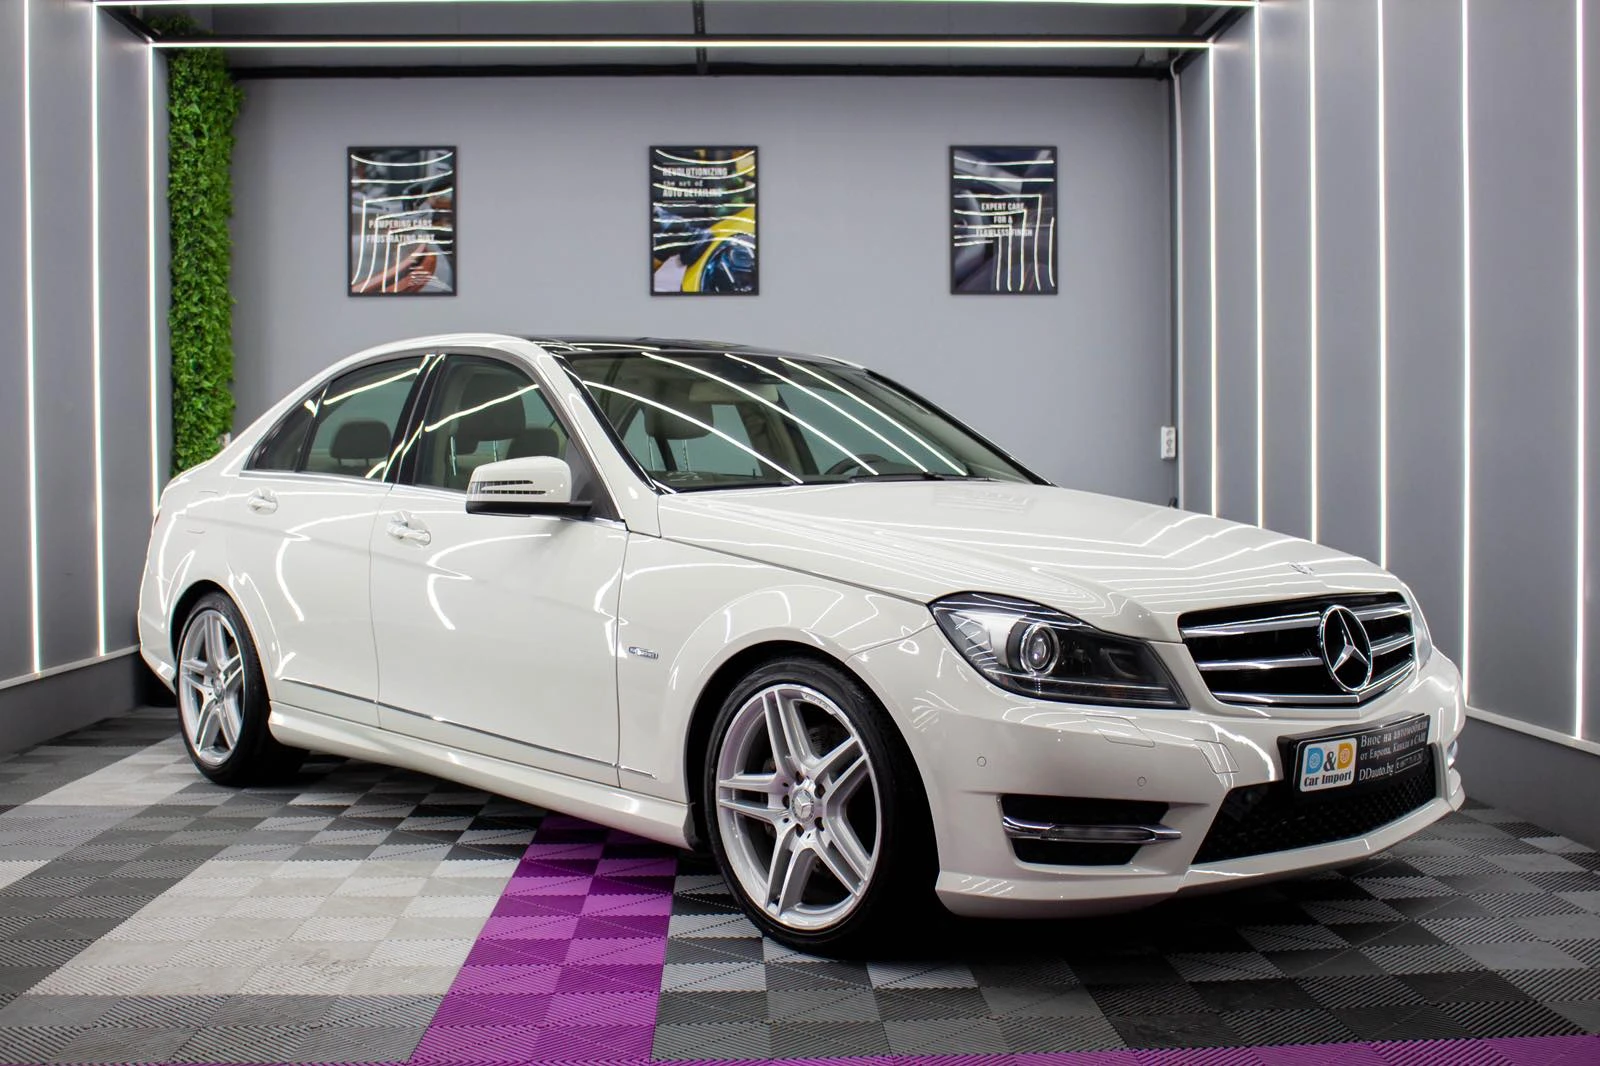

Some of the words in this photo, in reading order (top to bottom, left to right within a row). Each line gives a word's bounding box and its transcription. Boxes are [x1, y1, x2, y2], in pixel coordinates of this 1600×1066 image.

[662, 167, 728, 177] REVOLUTIONIZING
[662, 188, 682, 197] AUTO
[368, 219, 411, 229] PAMPERING
[413, 219, 432, 228] CARS
[993, 216, 1007, 224] FOR
[1008, 216, 1013, 224] A
[976, 229, 1009, 237] FLAWLESS
[1361, 734, 1381, 748] Внос
[1383, 732, 1392, 743] на
[1360, 752, 1368, 760] от
[1359, 762, 1394, 781] DDauto.bg
[1304, 775, 1318, 787] Car
[1322, 770, 1352, 785] Import
